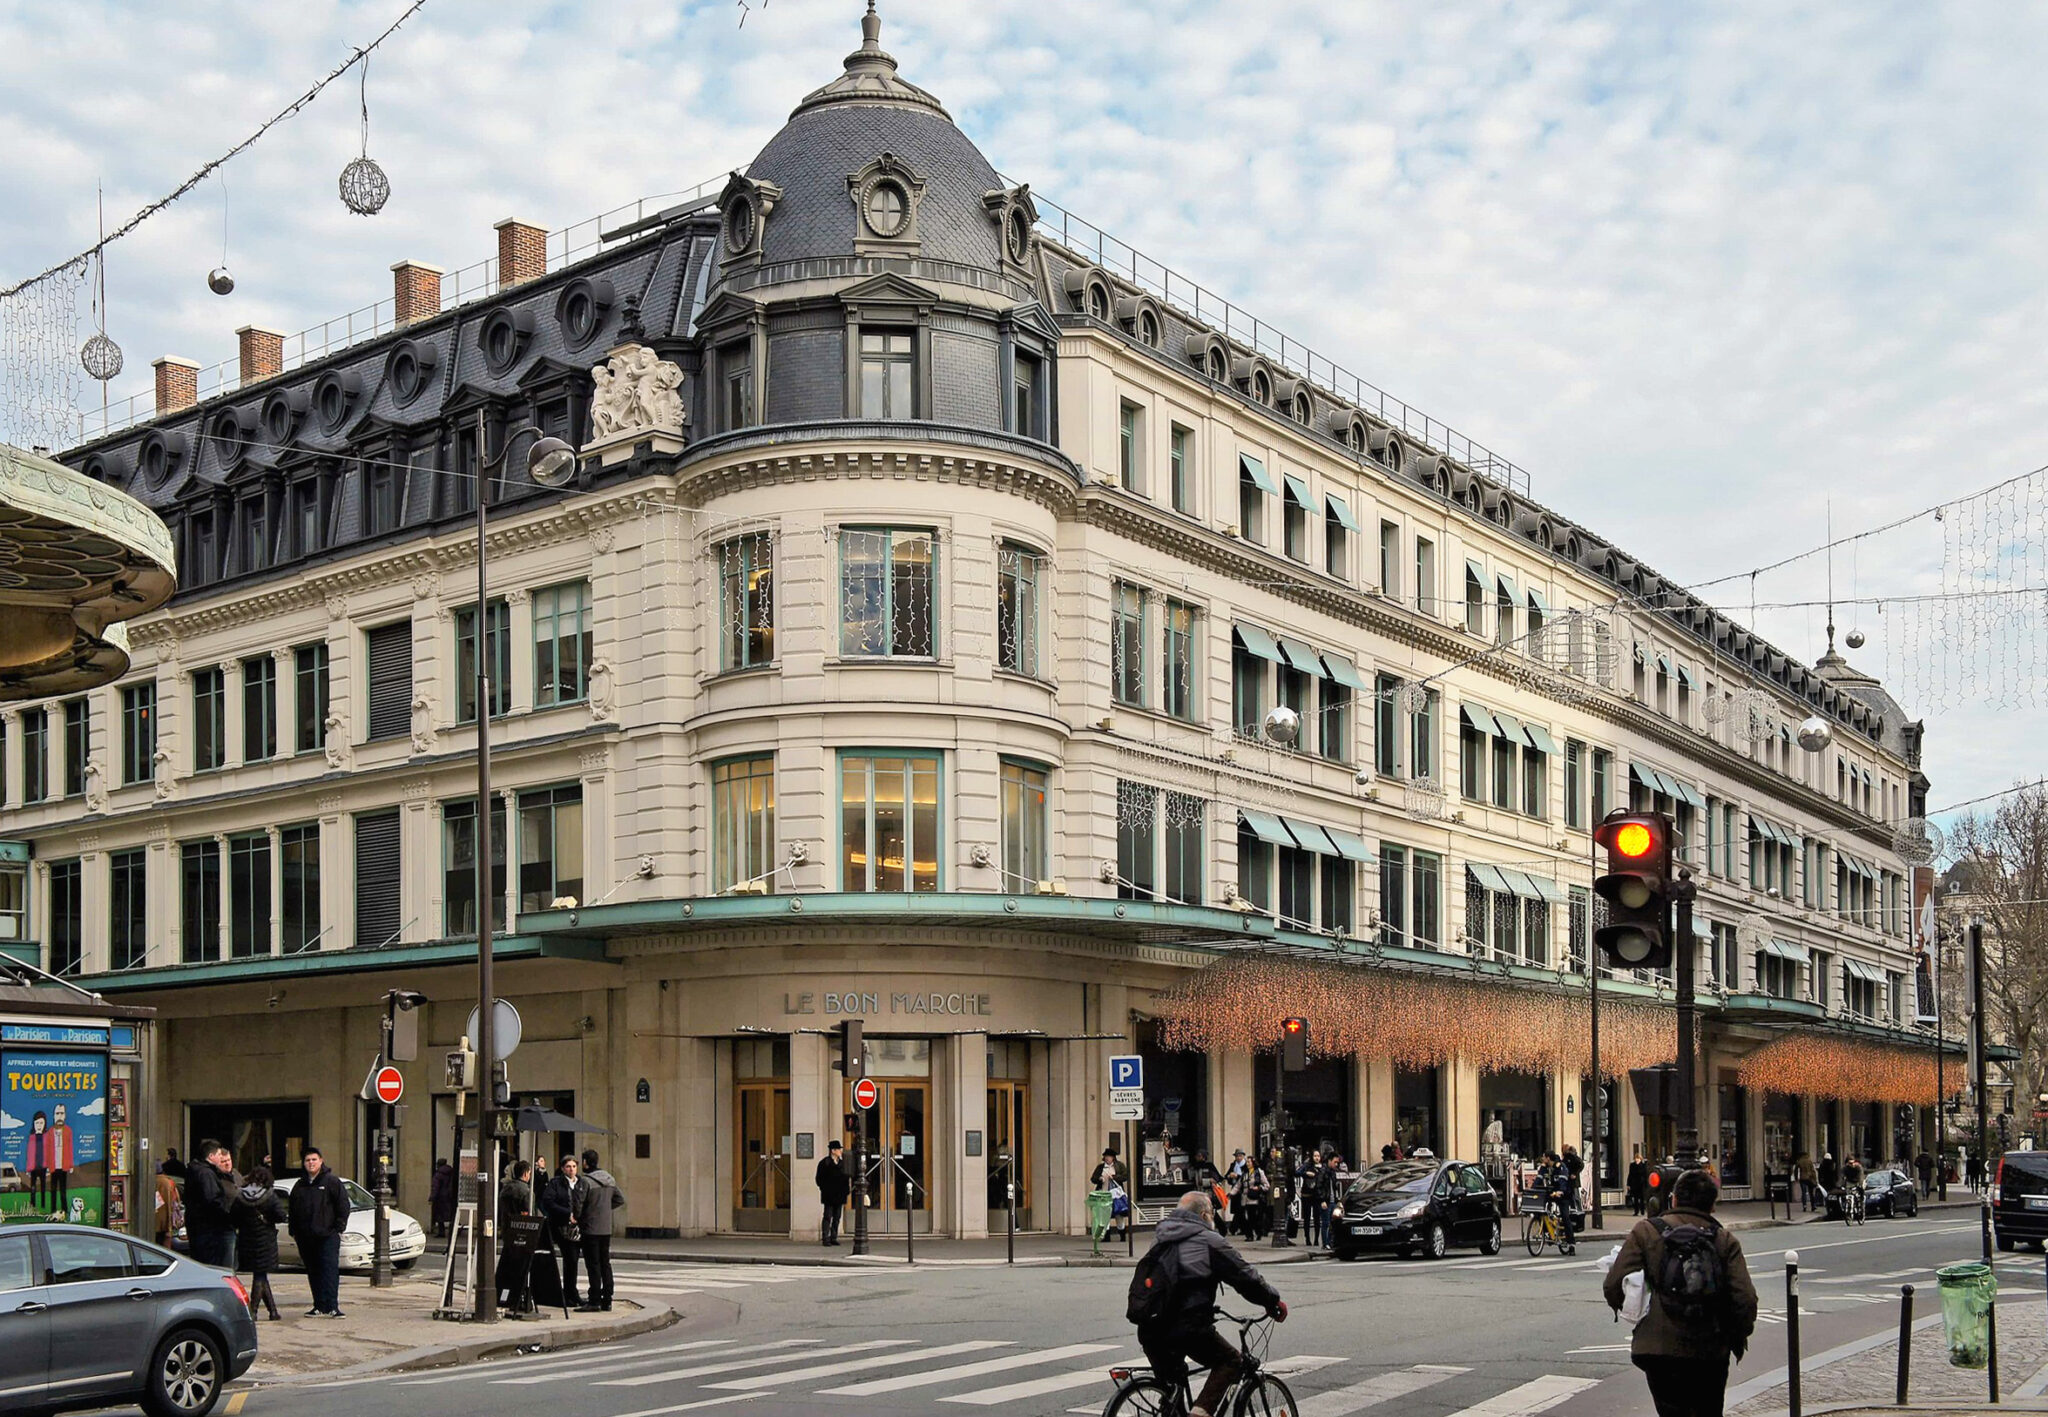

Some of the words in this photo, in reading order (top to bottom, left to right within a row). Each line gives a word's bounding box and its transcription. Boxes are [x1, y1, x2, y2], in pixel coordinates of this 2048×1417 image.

[785, 993, 814, 1014] LE
[824, 992, 879, 1014] BON
[890, 993, 992, 1015] MARCHE
[14, 1026, 50, 1041] Parisien
[68, 1028, 101, 1043] Parisien
[8, 1072, 98, 1091] TOURISTES
[1119, 1063, 1133, 1082] P
